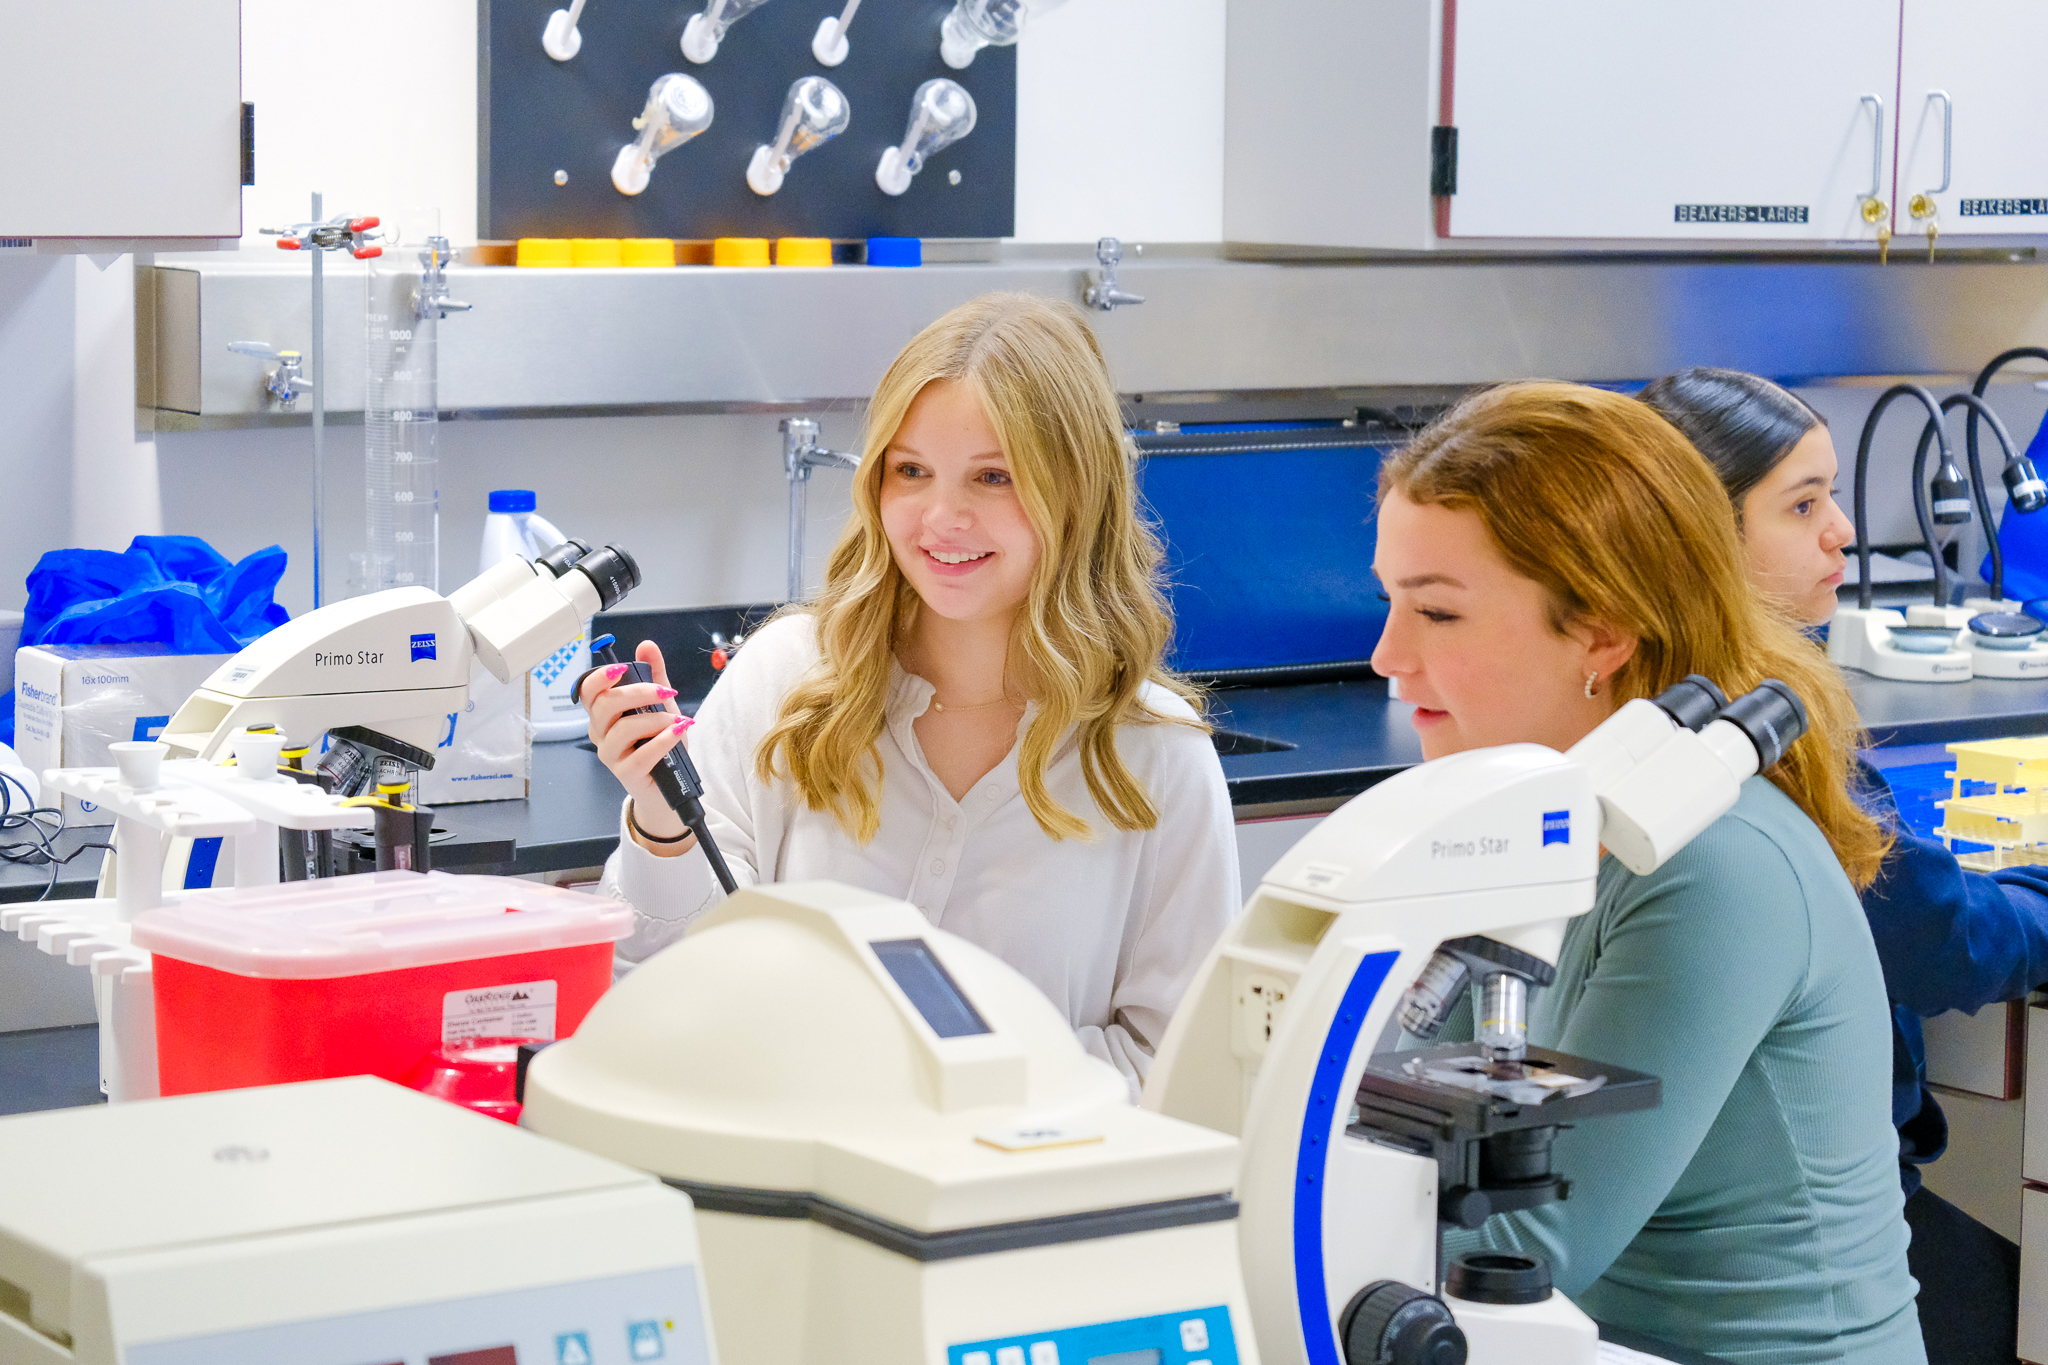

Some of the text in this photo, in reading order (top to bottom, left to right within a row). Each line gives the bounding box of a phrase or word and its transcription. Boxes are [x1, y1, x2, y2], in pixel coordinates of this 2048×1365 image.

[1962, 199, 2048, 215] BEAKERS-LA
[389, 330, 412, 341] 1000
[393, 370, 413, 381] 900
[393, 410, 413, 421] 800
[394, 451, 413, 462] 700
[394, 491, 414, 502] 600
[395, 531, 414, 542] 500
[395, 571, 414, 582] 400
[410, 639, 436, 649] ZEISS
[315, 651, 384, 666] Primo Star
[451, 773, 514, 782] www.fishersci.com
[673, 769, 688, 796] Thermo
[1431, 836, 1510, 859] Primo Star
